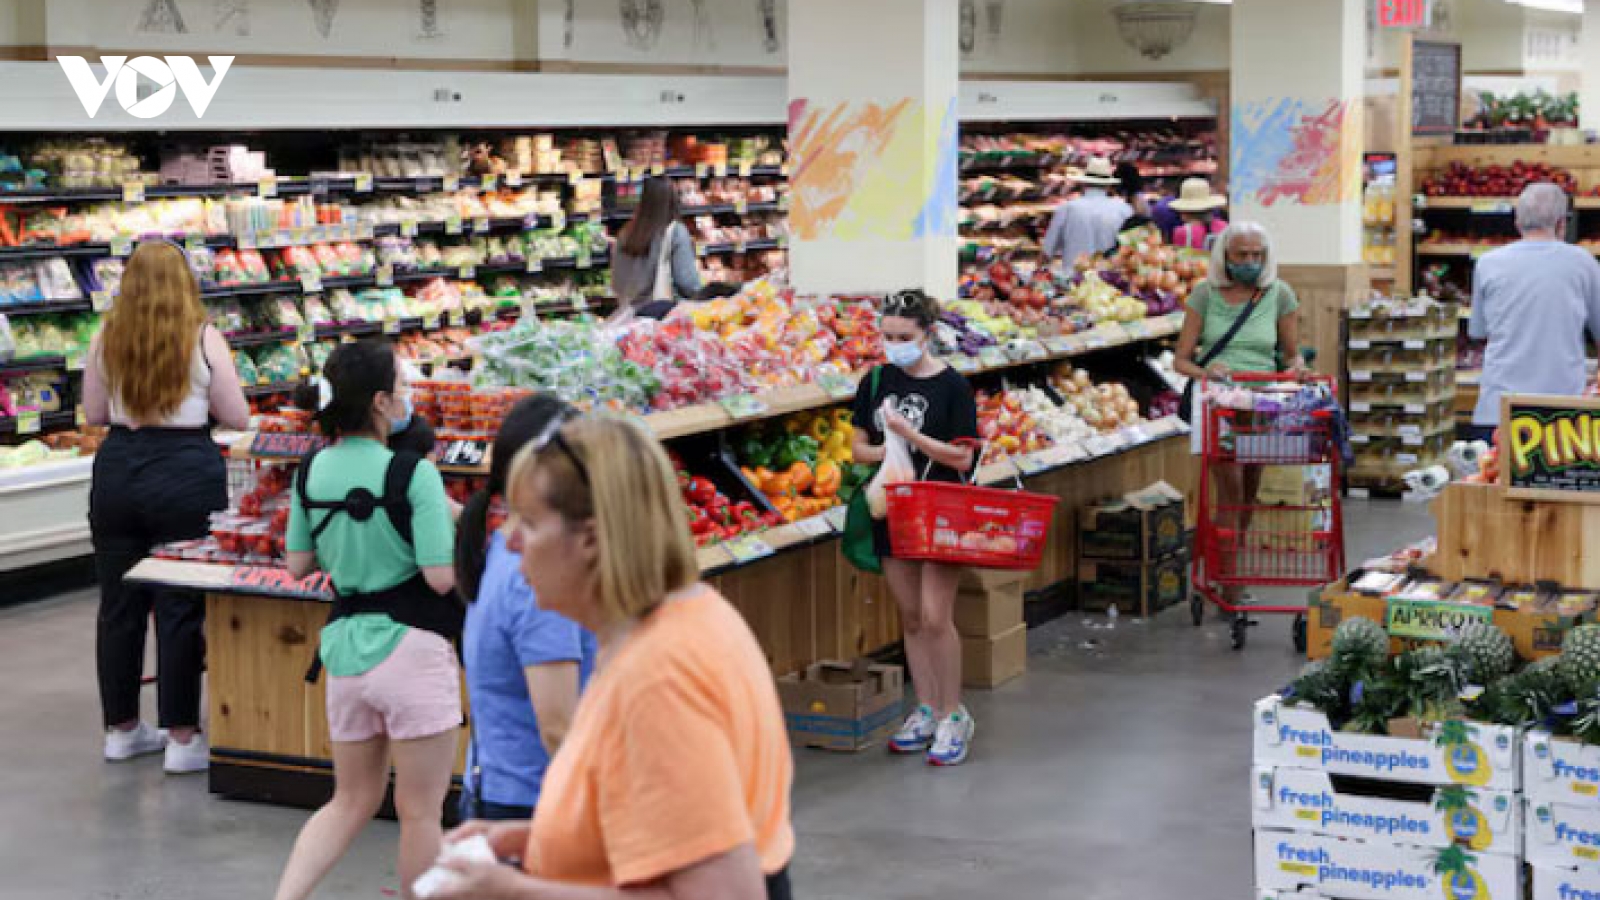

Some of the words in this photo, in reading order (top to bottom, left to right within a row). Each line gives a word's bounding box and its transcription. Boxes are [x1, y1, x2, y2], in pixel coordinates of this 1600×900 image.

[1379, 0, 1424, 26] EXIT
[1511, 413, 1600, 470] PIN
[1279, 725, 1333, 746] fresh
[1322, 746, 1430, 772] pineapples
[1279, 786, 1333, 807] fresh
[1322, 807, 1429, 835] pineapples
[1277, 843, 1330, 864] fresh
[1319, 863, 1427, 890] pineapples
